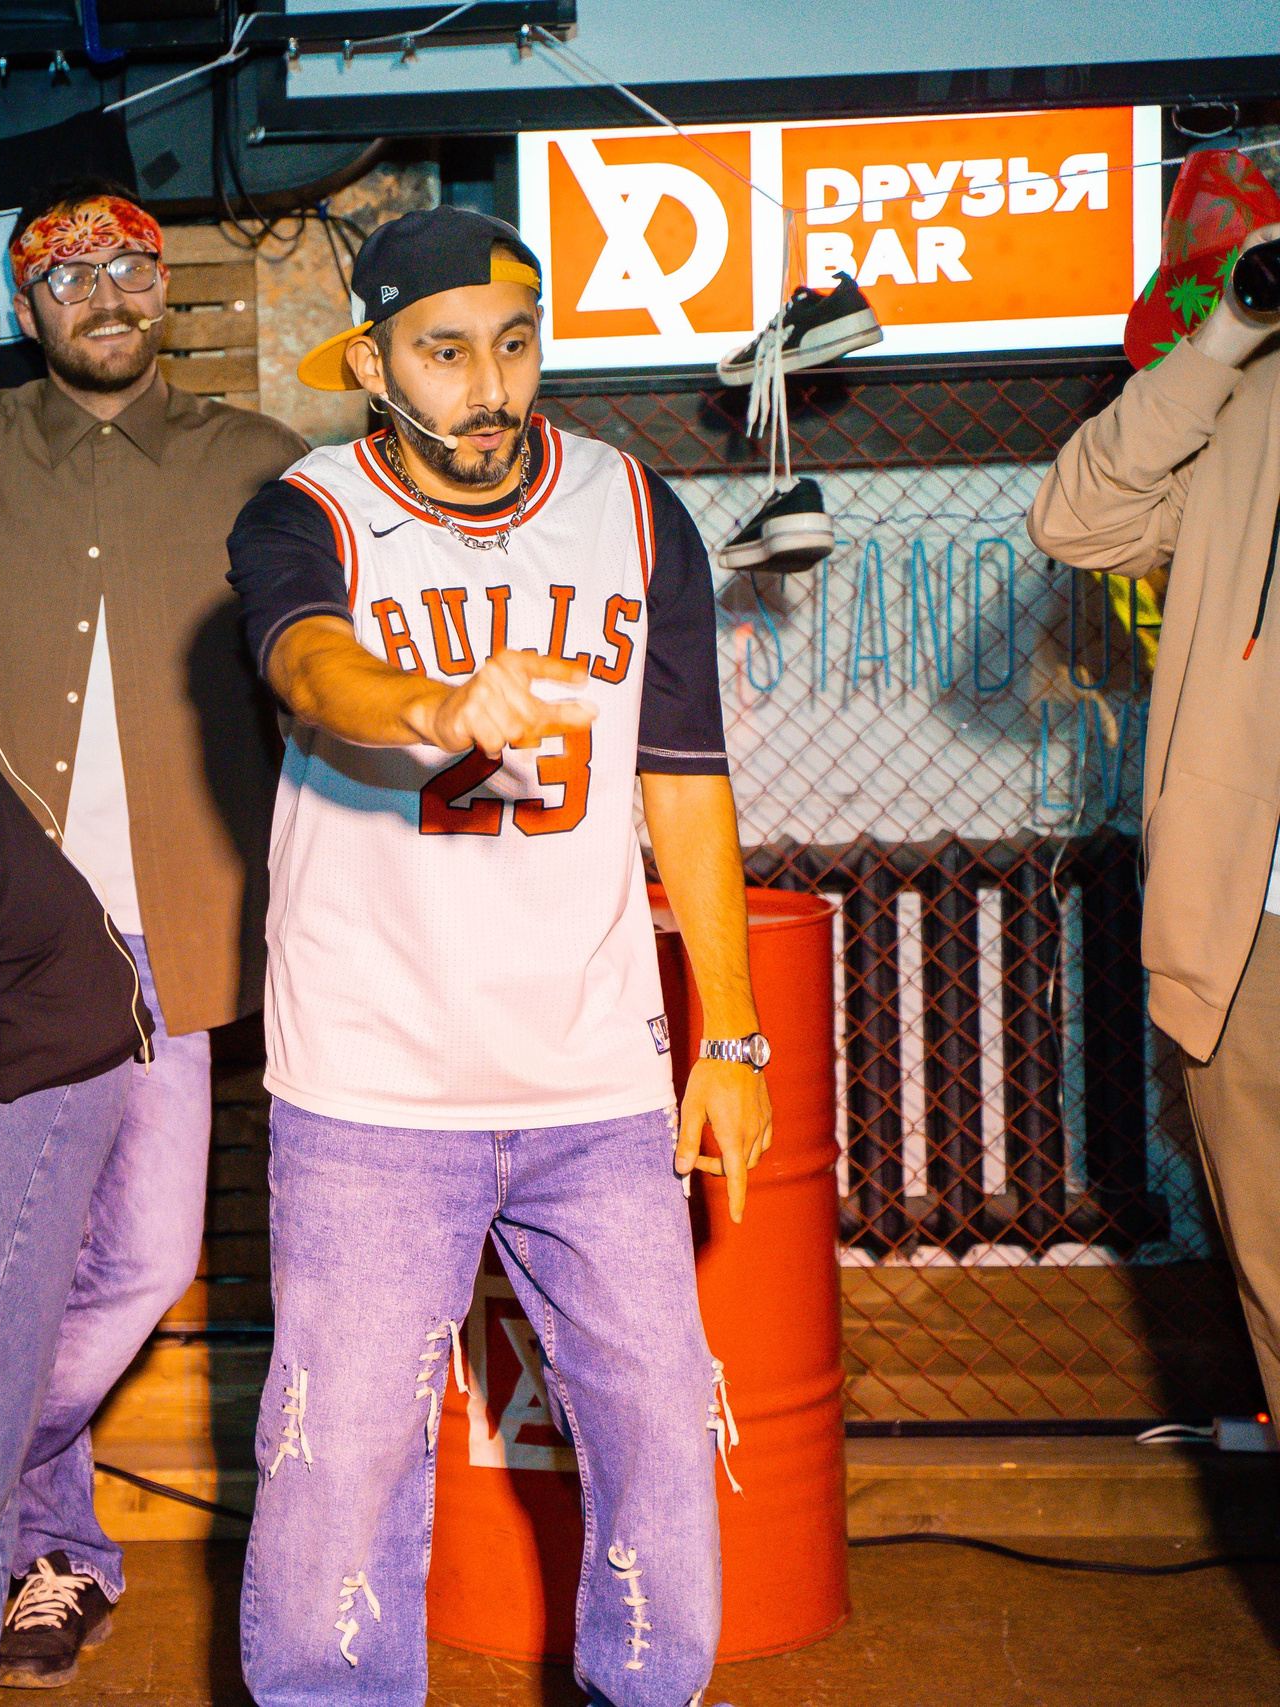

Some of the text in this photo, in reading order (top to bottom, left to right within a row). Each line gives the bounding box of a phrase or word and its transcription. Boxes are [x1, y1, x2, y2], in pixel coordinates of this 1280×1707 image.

[806, 226, 973, 291] BAR
[371, 584, 642, 685] BULLS
[747, 538, 1014, 692] STAND
[419, 718, 593, 837] 23
